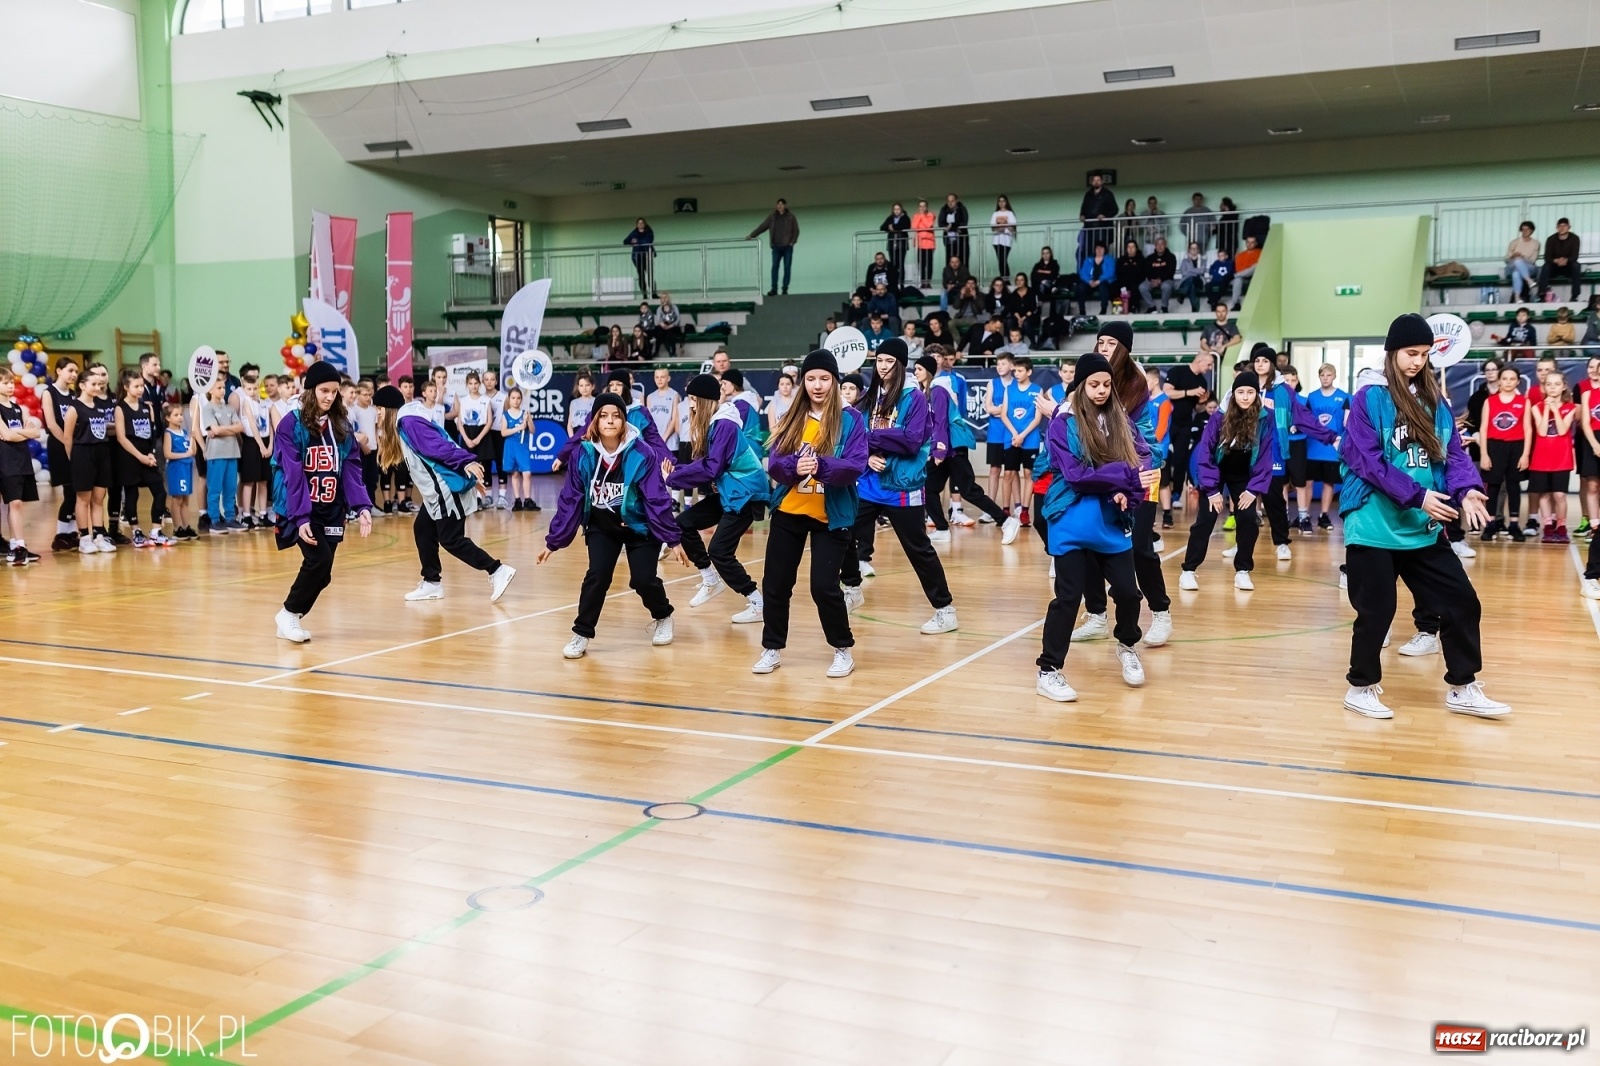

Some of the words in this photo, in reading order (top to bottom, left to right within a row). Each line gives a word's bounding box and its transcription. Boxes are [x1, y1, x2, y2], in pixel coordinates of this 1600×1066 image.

[1432, 322, 1463, 337] UNDER
[321, 328, 348, 373] IN
[830, 342, 866, 358] PURS
[529, 389, 565, 414] SiR
[528, 431, 556, 452] LO
[303, 445, 338, 473] US
[1407, 447, 1428, 468] 12
[180, 479, 187, 492] 5
[309, 476, 337, 503] 13
